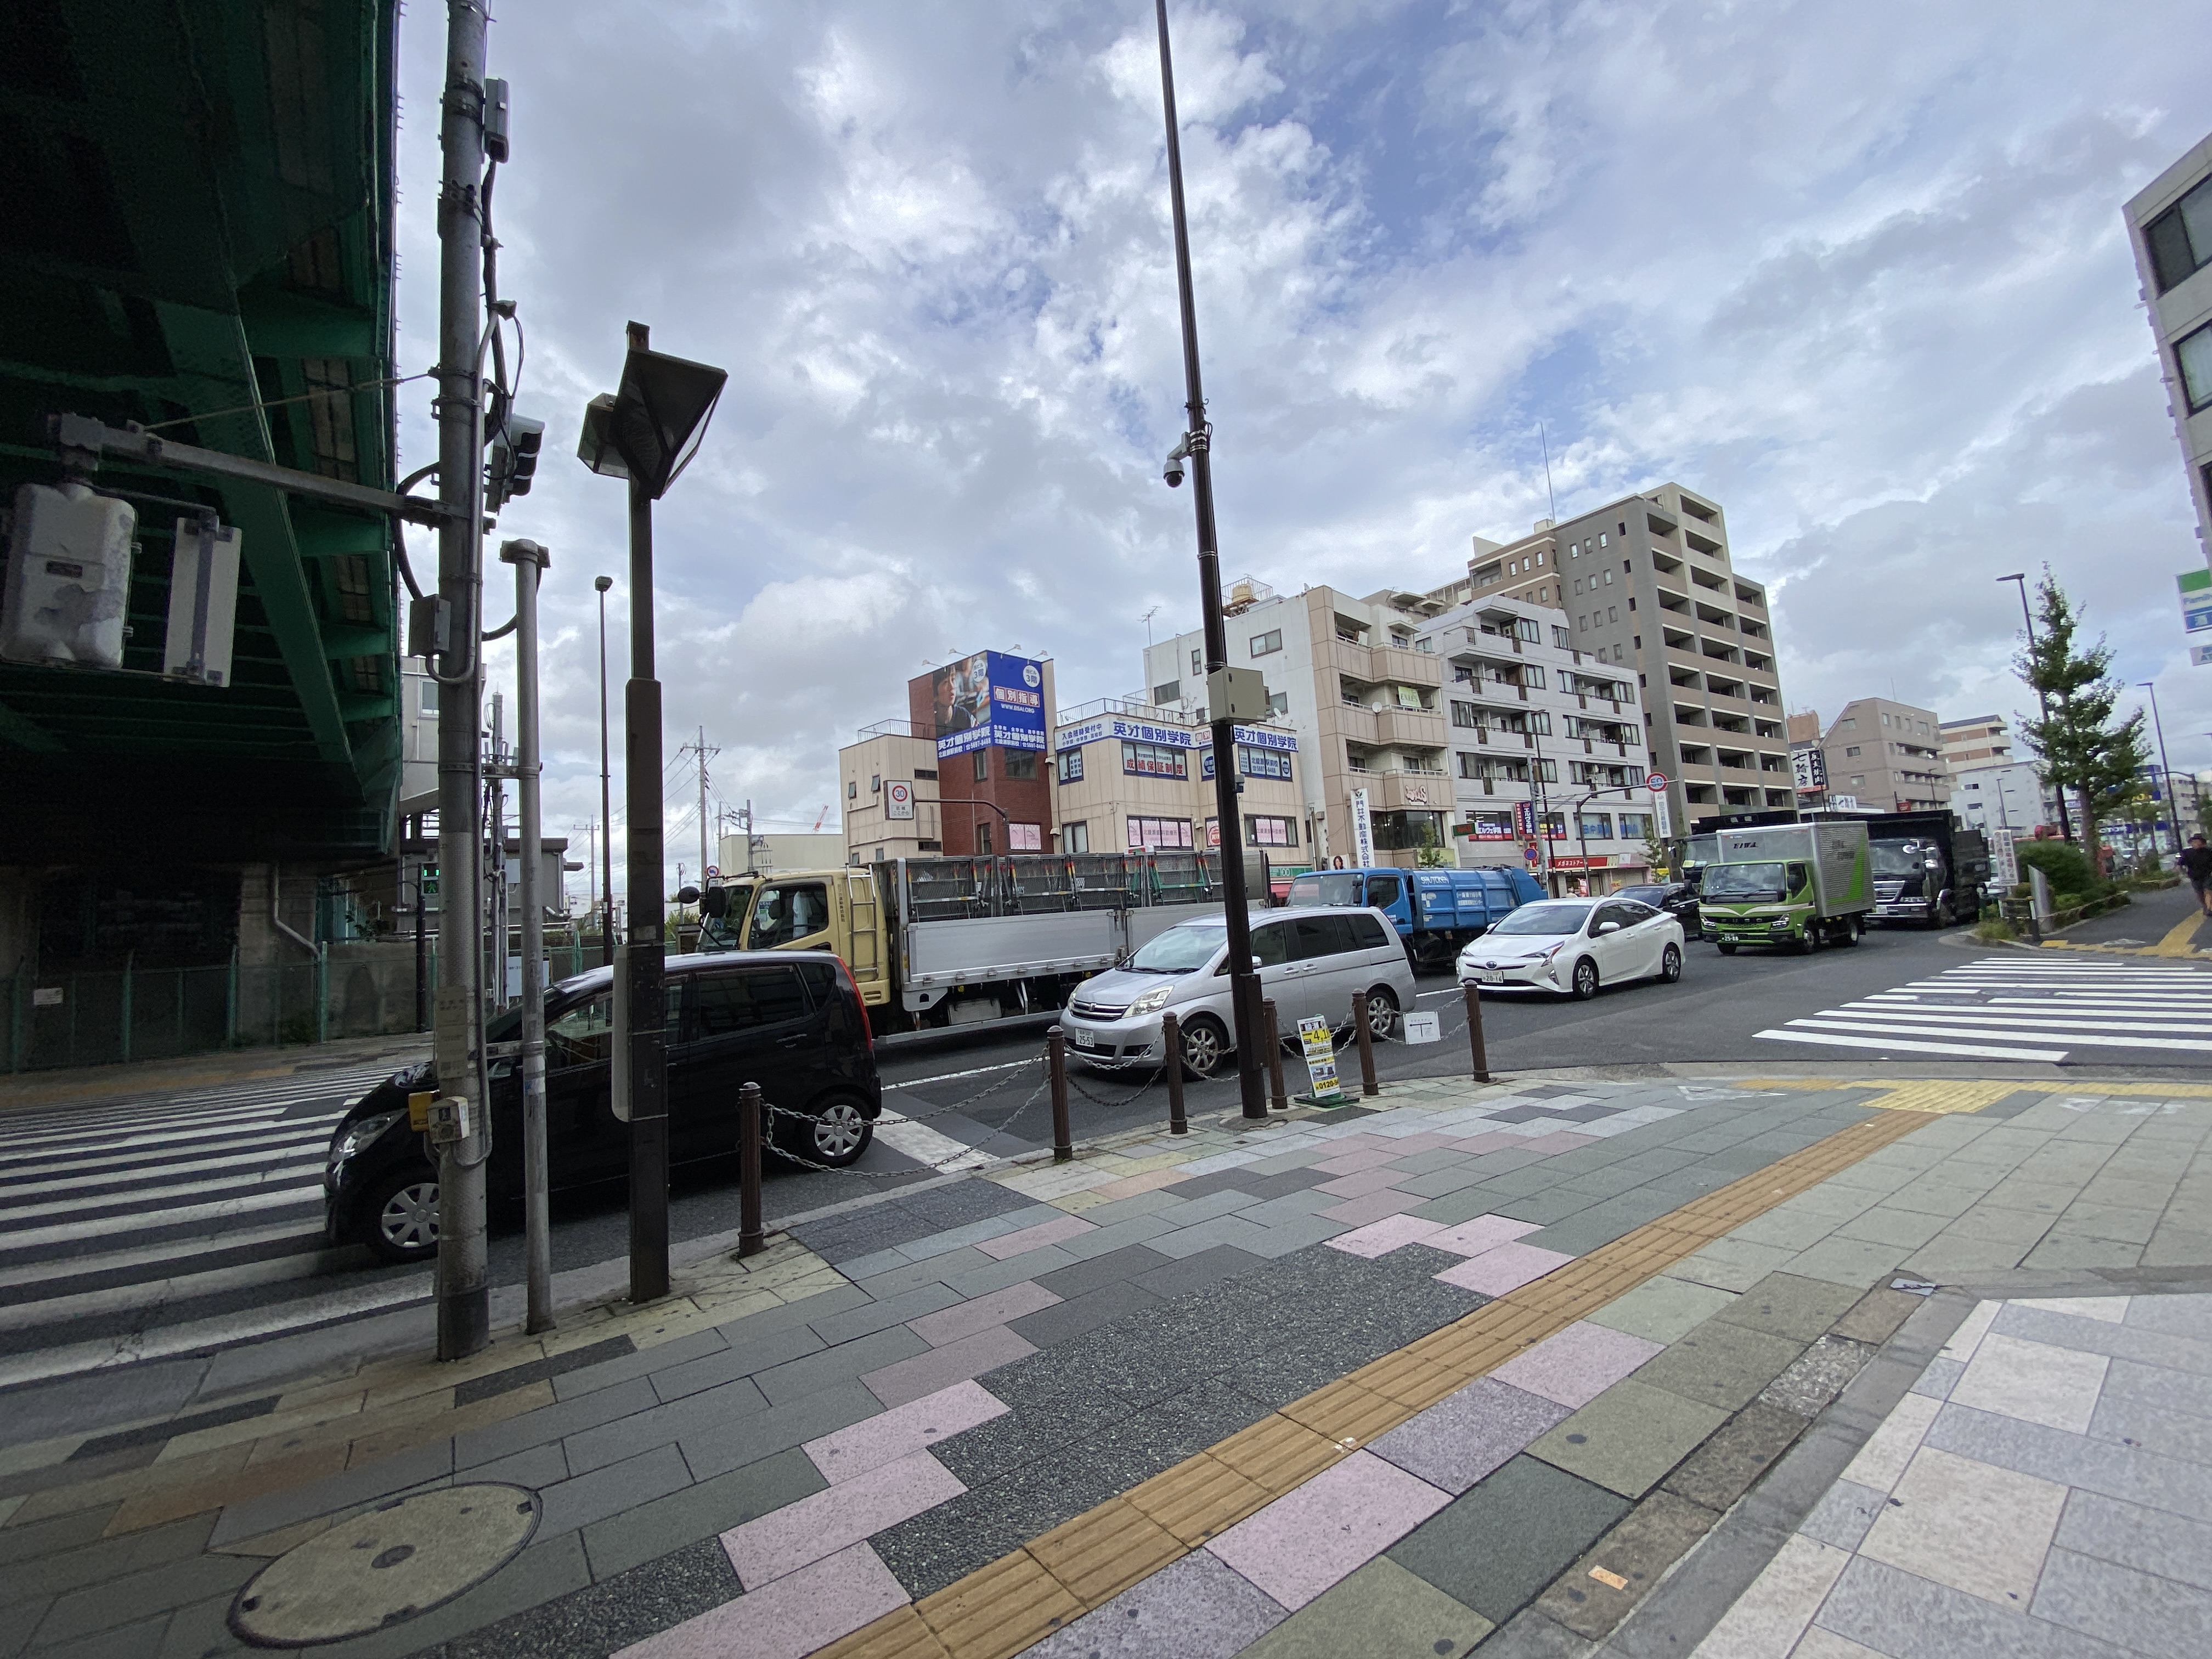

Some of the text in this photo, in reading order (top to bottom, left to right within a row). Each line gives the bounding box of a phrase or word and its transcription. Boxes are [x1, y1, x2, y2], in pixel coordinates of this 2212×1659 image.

[995, 687, 1039, 706] 個別指導
[938, 726, 991, 750] 英才個別学院
[994, 730, 1045, 744] 英才個別学院
[1062, 723, 1102, 741] 入会随時受付中
[1113, 721, 1192, 746] 英才個別学院
[1234, 727, 1297, 749] 英才個別学院
[1127, 758, 1183, 774] 成績保証制度
[1651, 778, 1663, 787] 50
[1079, 1035, 1093, 1046] 25-53
